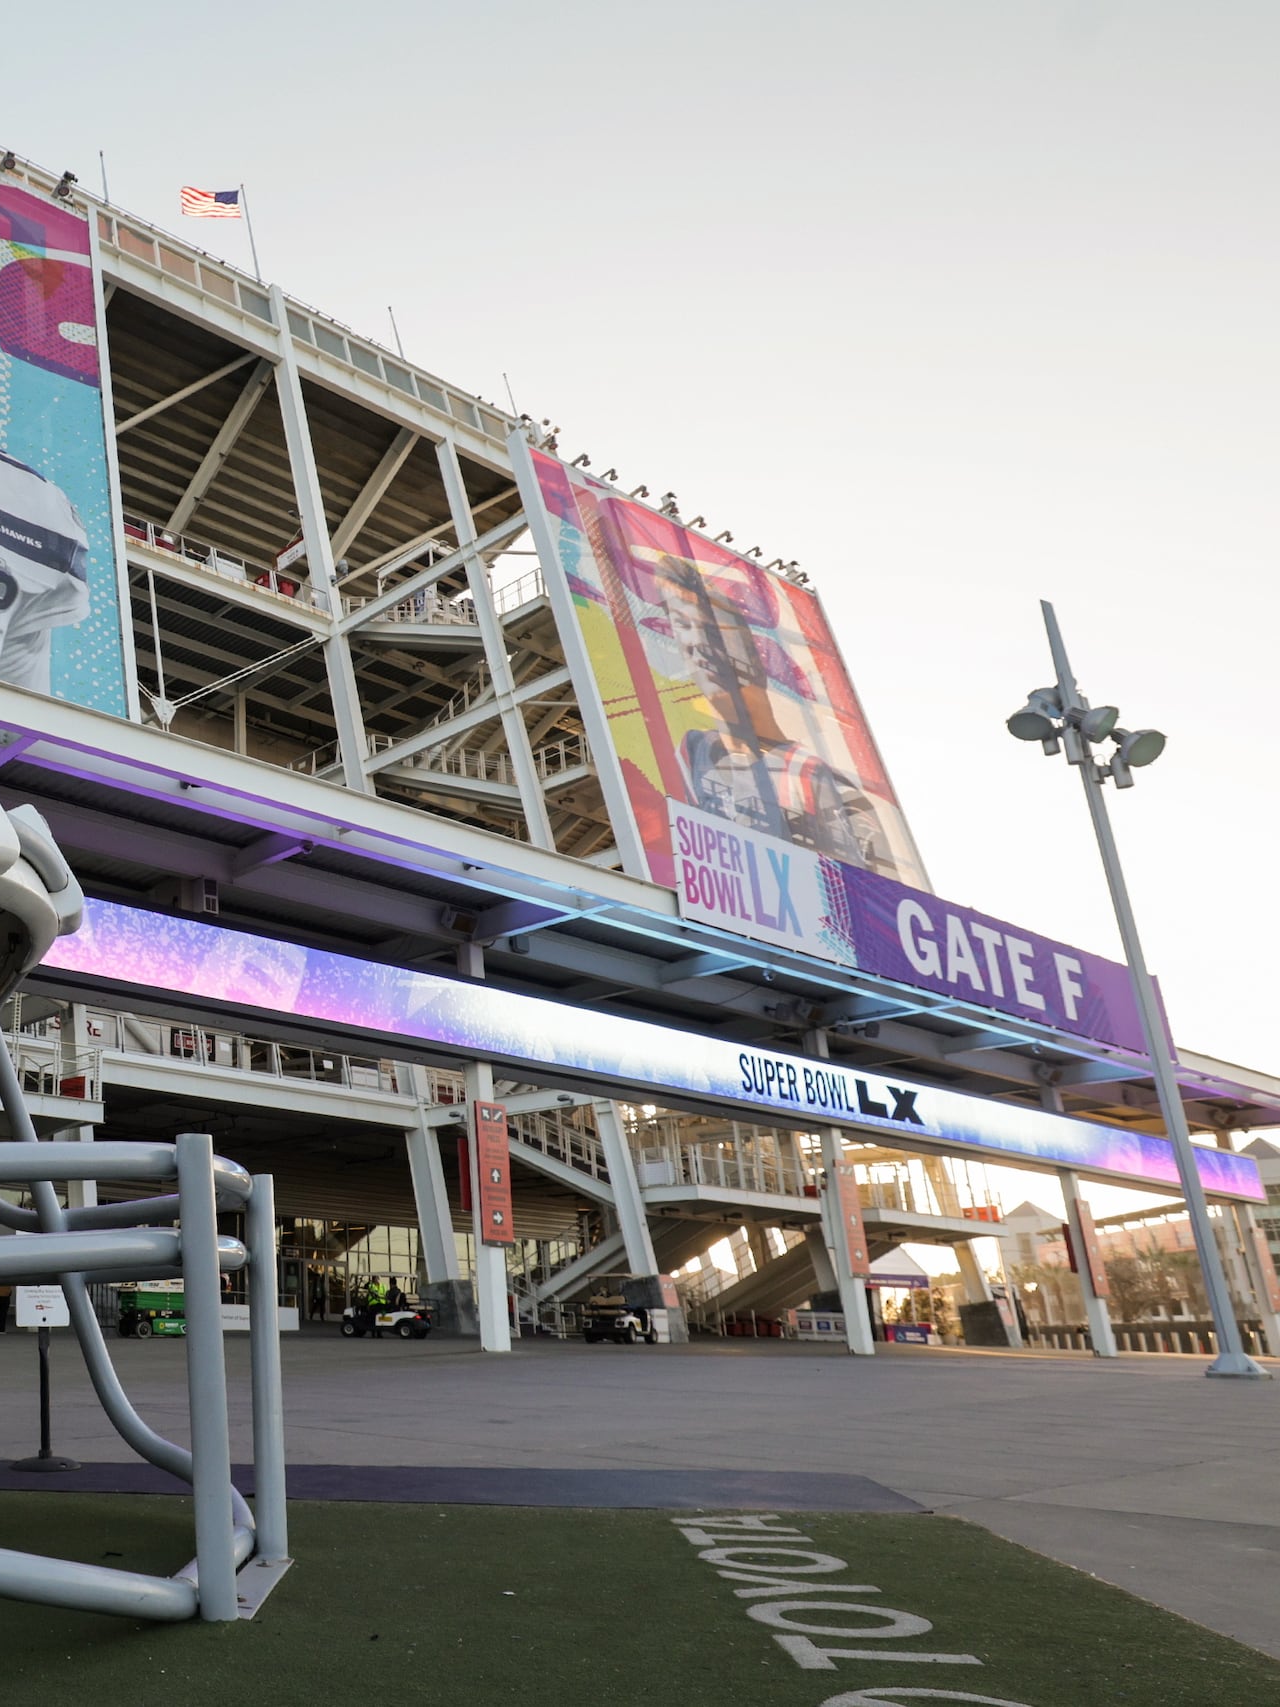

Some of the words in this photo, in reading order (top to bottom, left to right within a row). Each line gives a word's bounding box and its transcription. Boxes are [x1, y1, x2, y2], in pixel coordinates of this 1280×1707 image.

[676, 815, 744, 874] SUPER
[682, 858, 752, 921] BOWL
[744, 839, 803, 938] LX
[897, 899, 1046, 1011] GATE
[1053, 952, 1083, 1021] F
[739, 1053, 800, 1102] SUPER
[803, 1067, 854, 1112] BOWL
[854, 1079, 925, 1126] LX
[670, 1514, 985, 1670] TOYOTA
